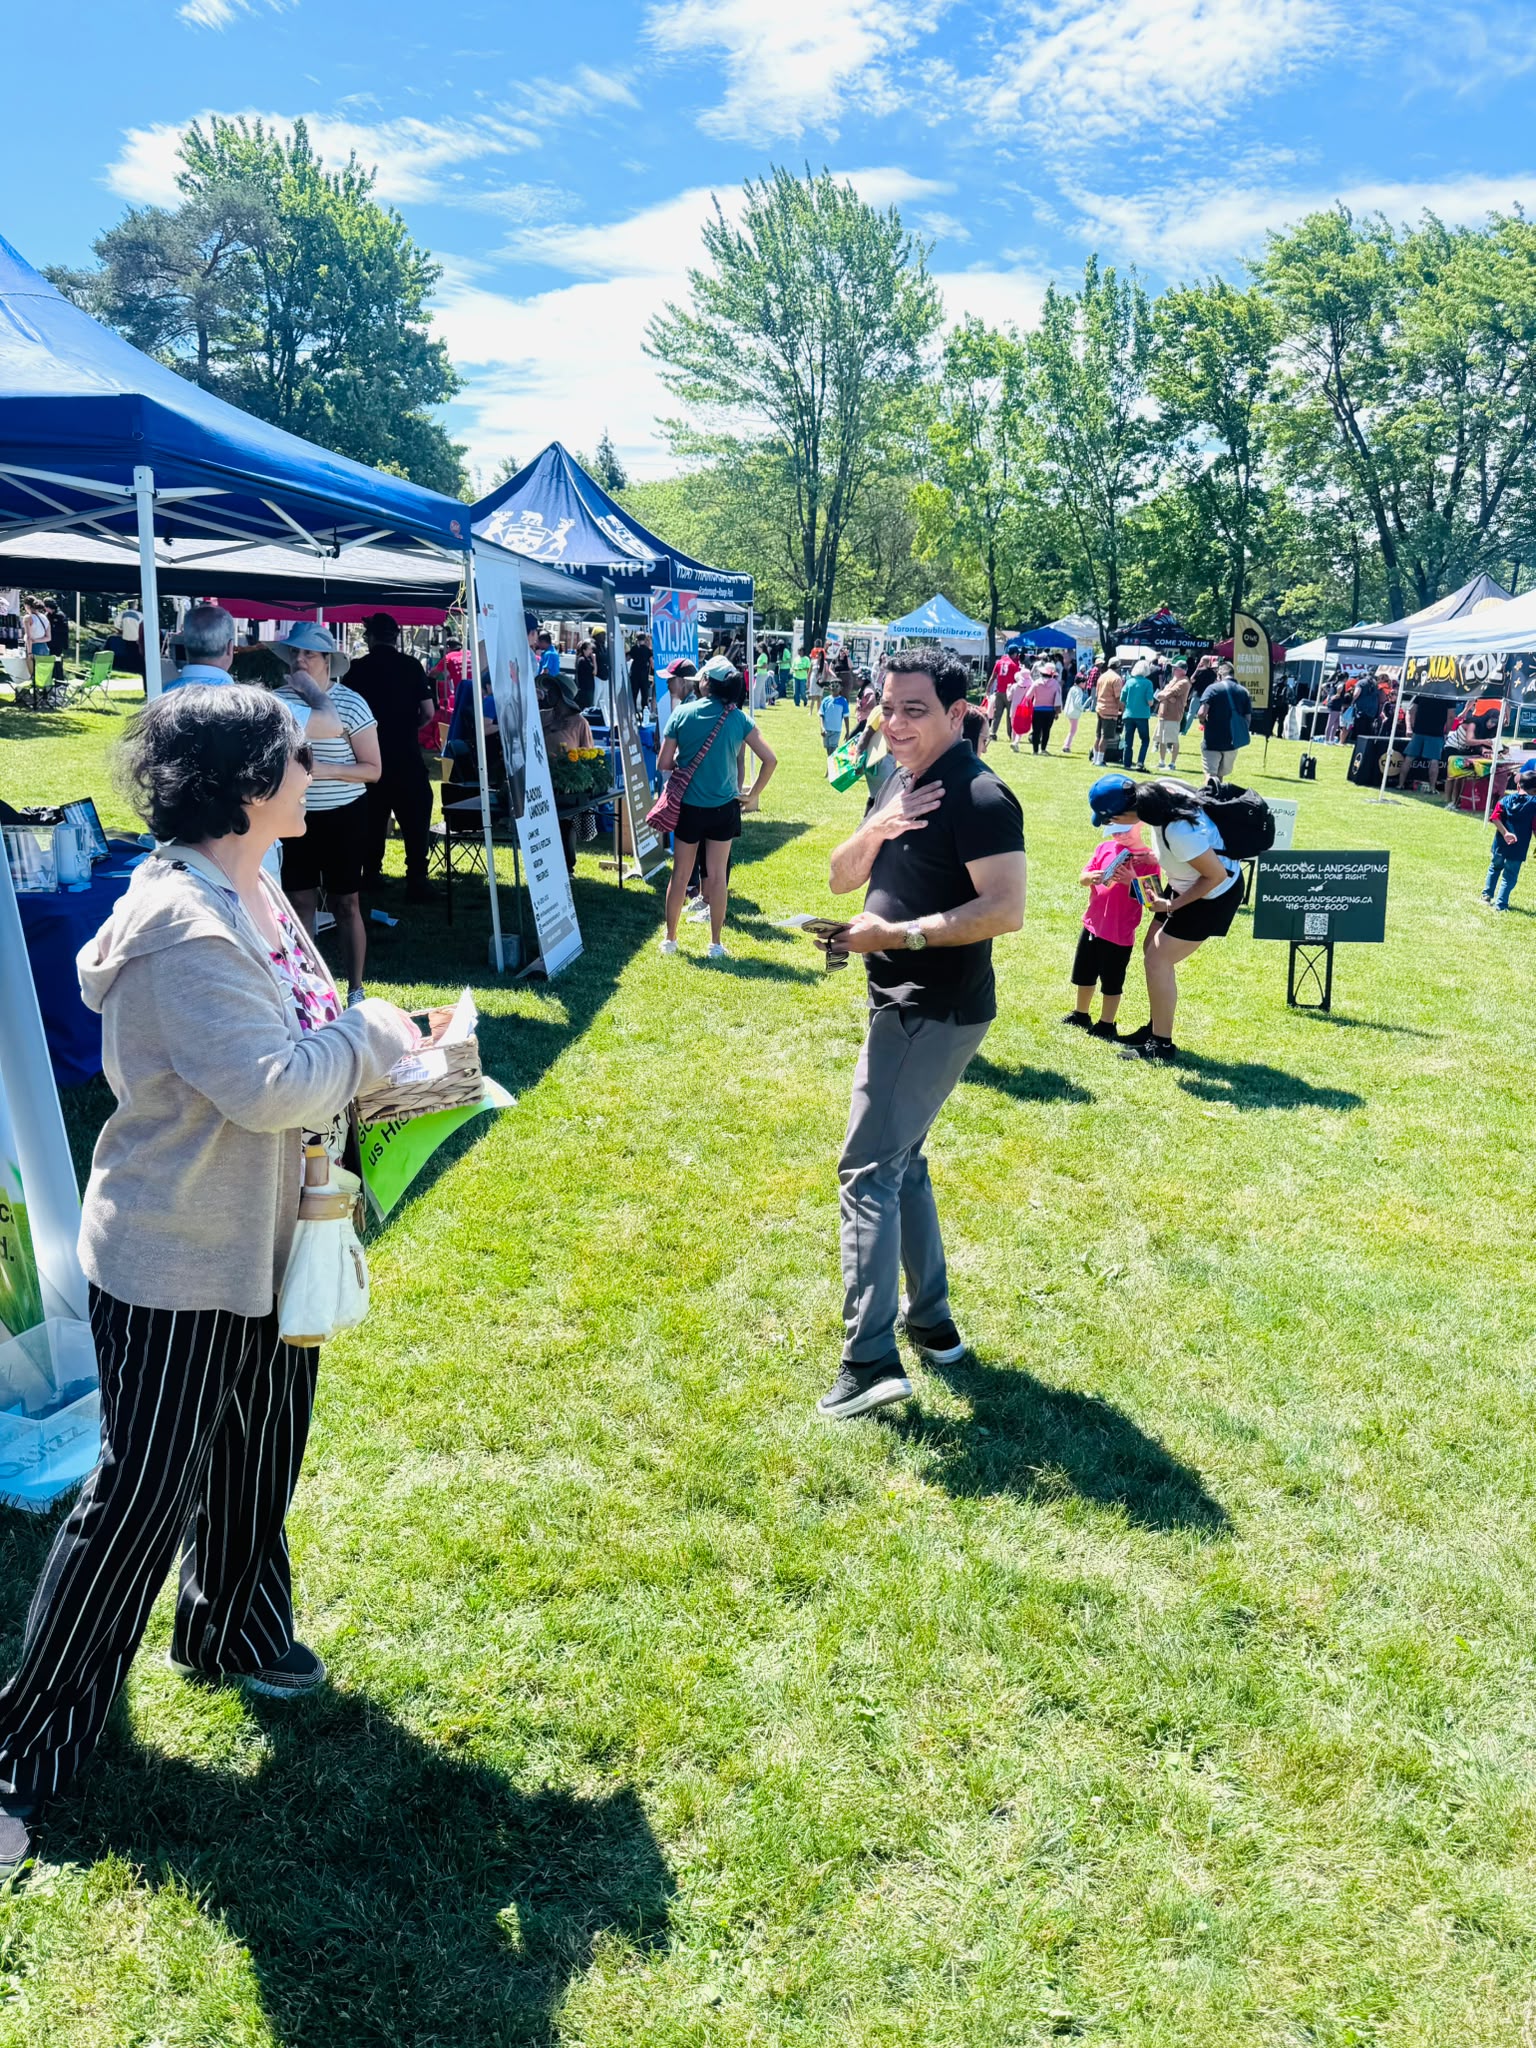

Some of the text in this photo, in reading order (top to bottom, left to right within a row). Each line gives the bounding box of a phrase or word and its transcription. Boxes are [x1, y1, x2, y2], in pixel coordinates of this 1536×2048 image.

[608, 561, 656, 577] MPP
[656, 620, 695, 652] VIJAY
[893, 625, 982, 637] torontopubliclibrary.ca
[1154, 638, 1177, 647] COME
[1177, 639, 1196, 648] JOIN
[1196, 640, 1210, 648] US!
[1427, 653, 1506, 682] KIDS ZONE
[1247, 680, 1259, 688] LOVE
[1318, 863, 1388, 874] LANDSCAPING
[1262, 895, 1373, 904] BLACKDOGLANDSCAPING.CA
[1285, 903, 1349, 912] 416-830-6000
[368, 1142, 384, 1167] us
